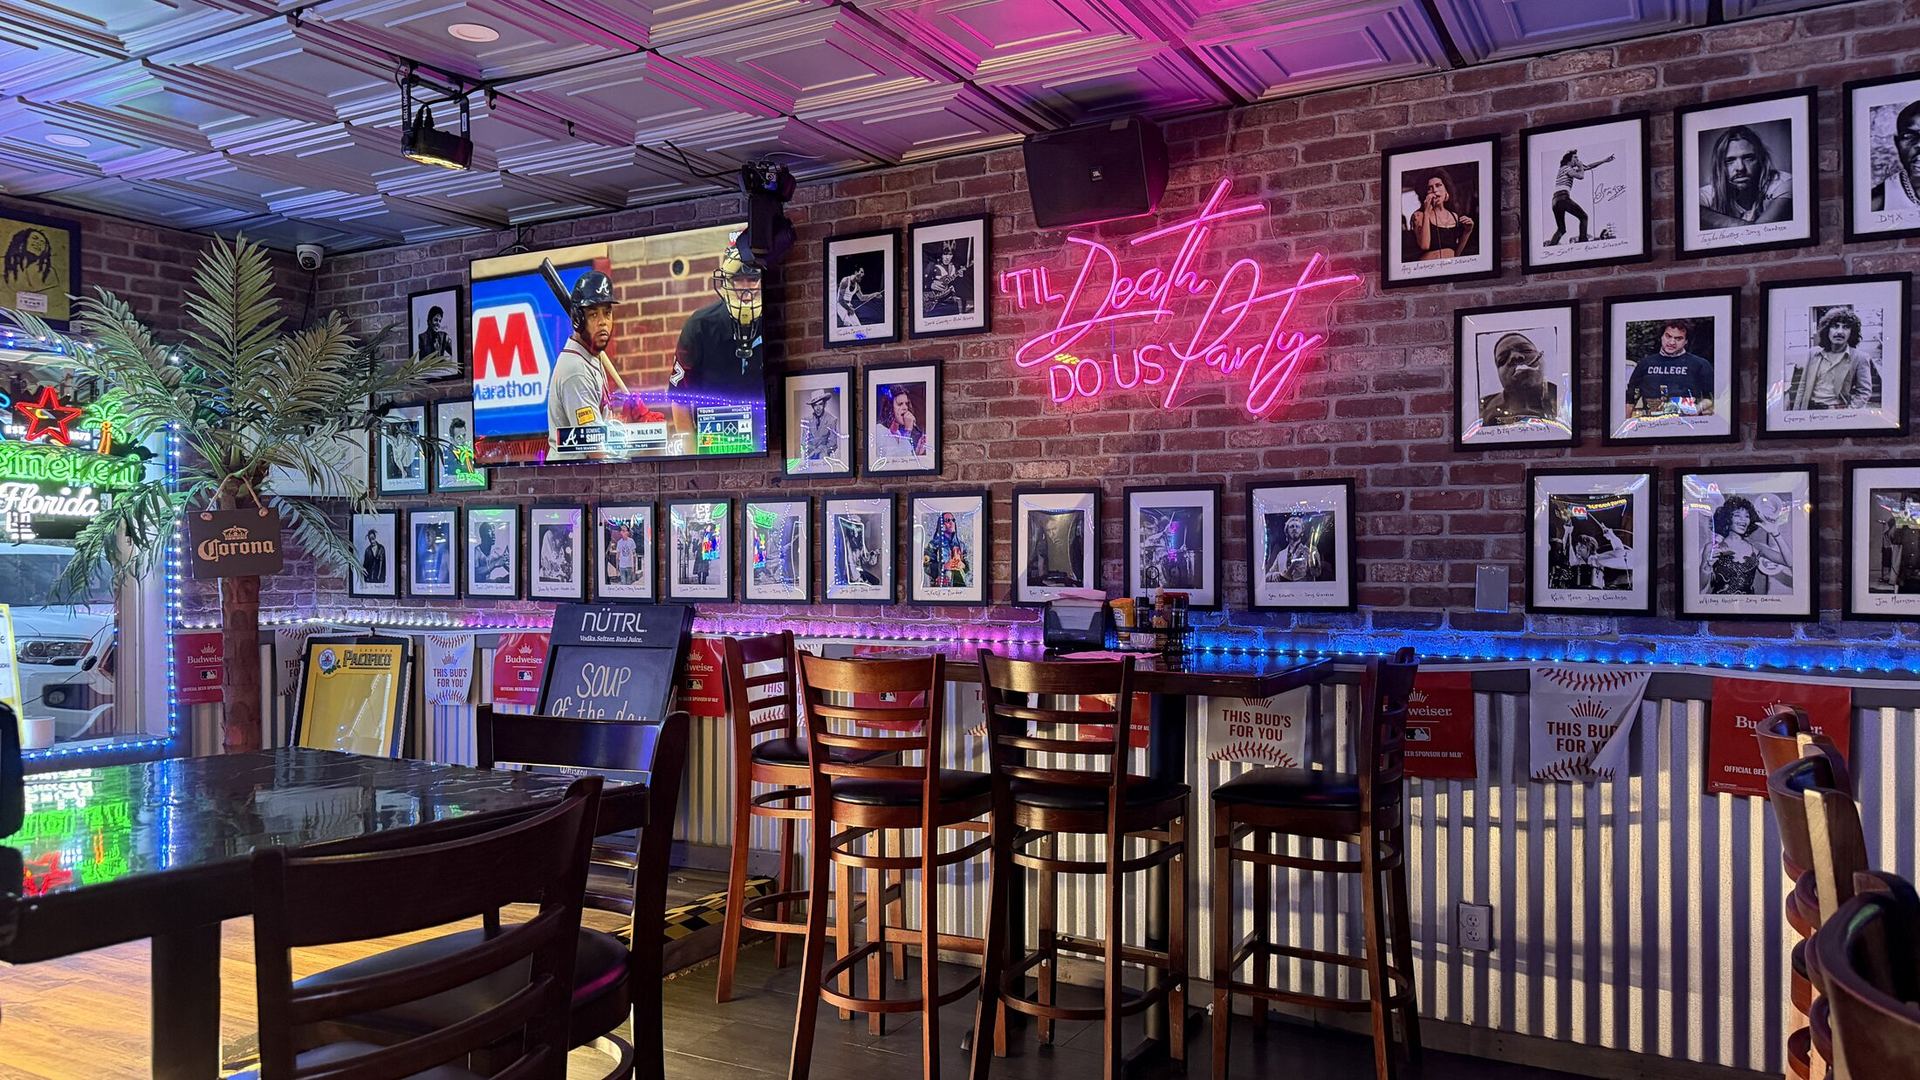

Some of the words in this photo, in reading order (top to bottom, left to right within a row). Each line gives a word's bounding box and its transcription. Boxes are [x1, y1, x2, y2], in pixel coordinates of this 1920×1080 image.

[1015, 177, 1266, 368] Death
[1049, 360, 1103, 404] DO
[1112, 343, 1168, 390] US
[1164, 252, 1362, 414] Party
[1647, 365, 1688, 375] COLLEGE
[0, 482, 100, 517] Florida
[198, 539, 276, 563] Corona
[289, 668, 300, 678] FO
[432, 668, 449, 678] THIS
[449, 667, 468, 678] BUD'S
[576, 662, 632, 699] SOUP
[437, 678, 449, 688] FOR
[449, 677, 464, 688] YOU
[577, 699, 606, 720] the
[1222, 708, 1251, 725] THIS
[1255, 712, 1292, 728] BUD'S
[1407, 705, 1453, 717] weiser
[1229, 725, 1256, 739] FOR
[1258, 726, 1284, 742] YOU
[1547, 720, 1582, 738] THIS
[1556, 737, 1586, 753] FOR
[1724, 765, 1752, 775] OFFICIAL
